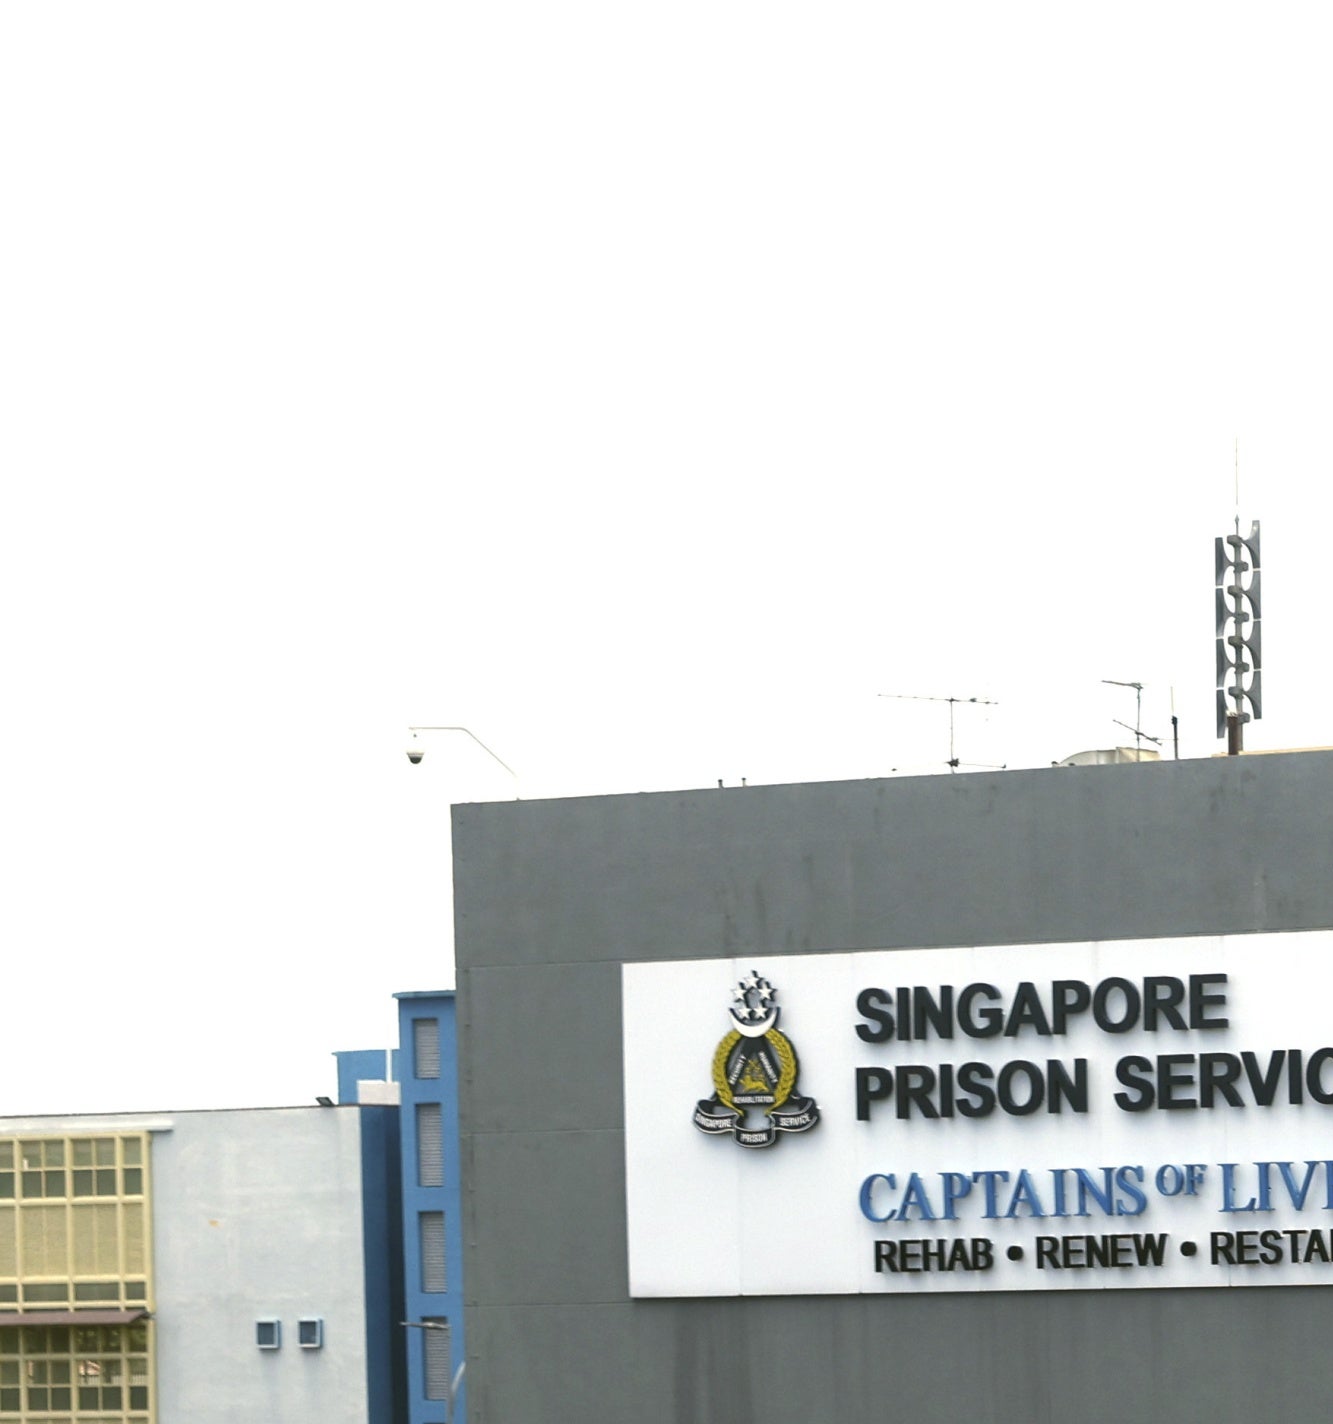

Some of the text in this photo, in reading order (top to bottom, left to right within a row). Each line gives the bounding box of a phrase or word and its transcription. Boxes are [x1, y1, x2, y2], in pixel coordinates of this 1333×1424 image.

[855, 973, 1229, 1043] SINGAPORE
[855, 1058, 1089, 1121] PRISON
[740, 1132, 767, 1143] PRISON
[779, 1114, 811, 1127] SERVICE
[858, 1166, 1148, 1223] CAPTAINS
[1157, 1163, 1207, 1196] OF
[873, 1237, 994, 1273] REHAB
[1036, 1232, 1168, 1270] RENEW
